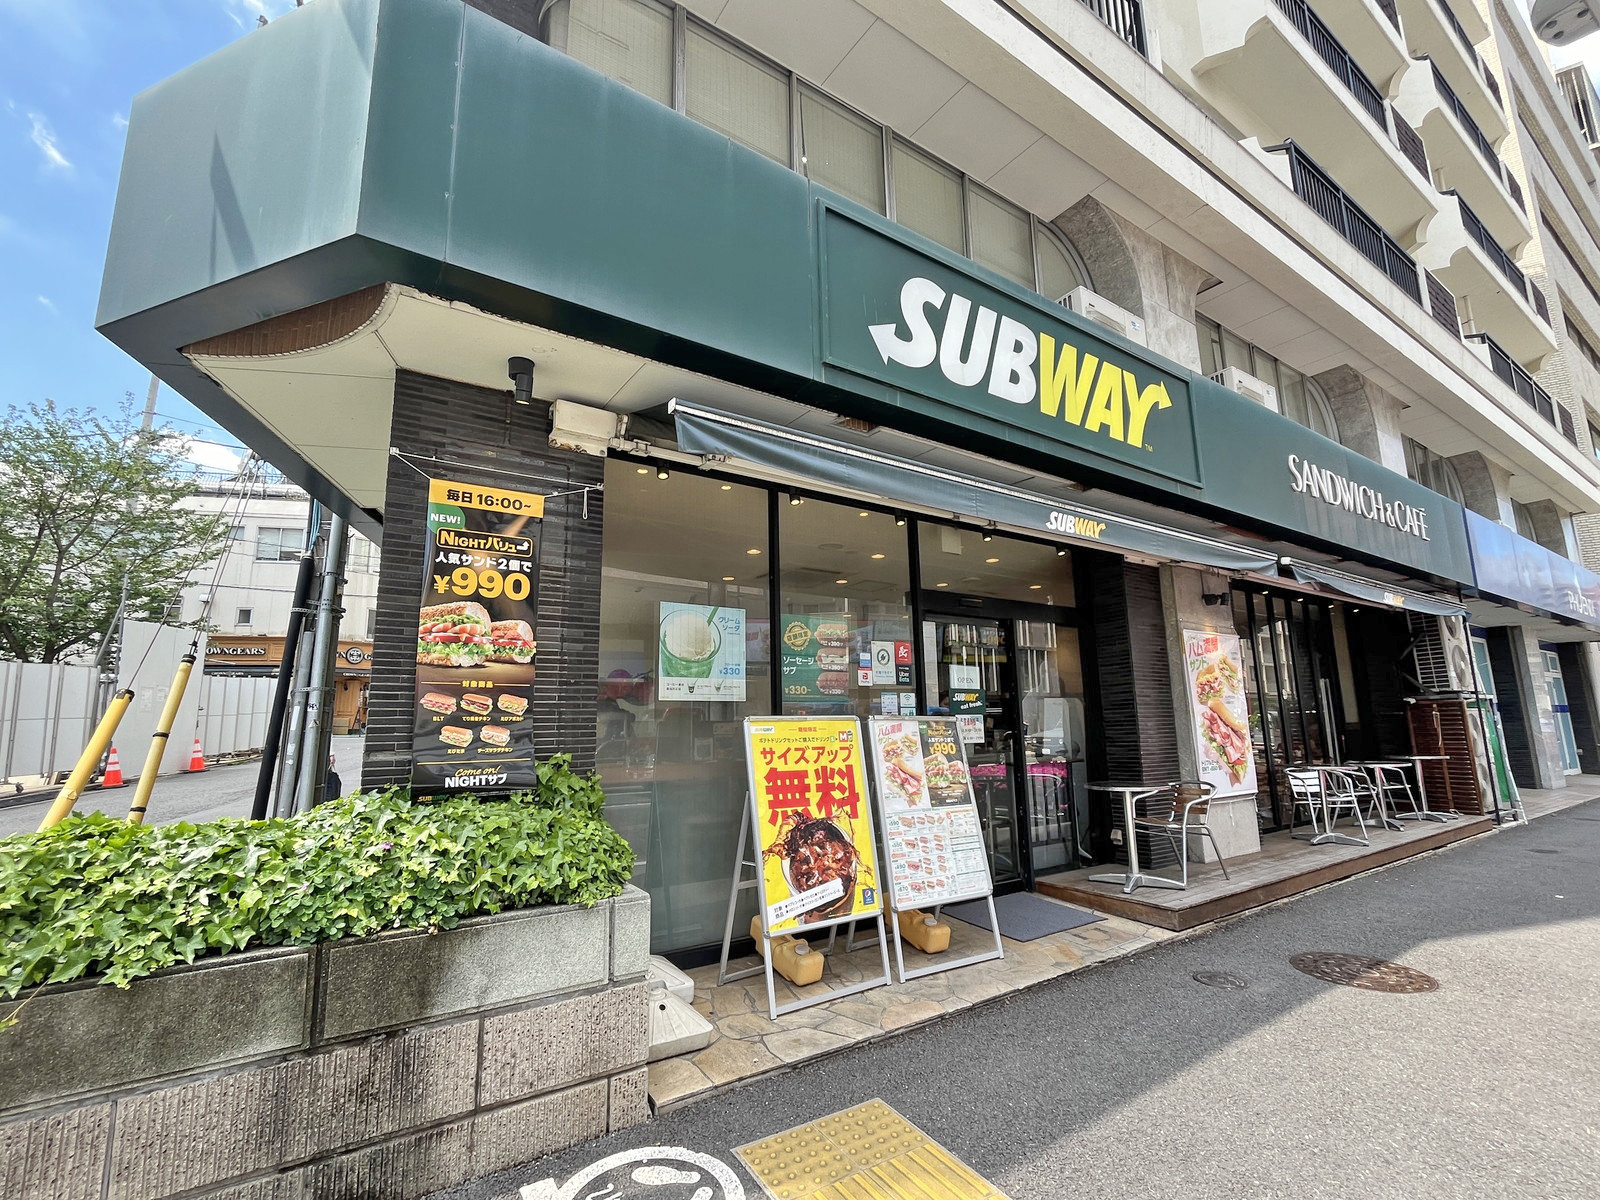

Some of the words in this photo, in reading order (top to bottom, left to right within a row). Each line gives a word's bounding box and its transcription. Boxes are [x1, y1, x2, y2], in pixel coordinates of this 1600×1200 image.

[868, 277, 1172, 449] SUBWAY
[447, 488, 473, 504] 毎日
[430, 513, 461, 524] NEW!
[1046, 511, 1106, 539] SUBWAY
[435, 551, 533, 572] 人気サンド2個で
[433, 566, 531, 601] ¥990
[718, 616, 741, 625] クリーム
[722, 624, 741, 632] ソーダ
[783, 656, 814, 665] ソーセージ
[1189, 656, 1209, 672] サンド
[719, 667, 741, 676] ¥330
[953, 692, 980, 702] SUBWAY
[760, 744, 855, 766] サイズアップ
[930, 742, 956, 755] ¥990
[455, 768, 481, 778] Come
[482, 764, 502, 775] on!
[764, 764, 860, 826] 無料
